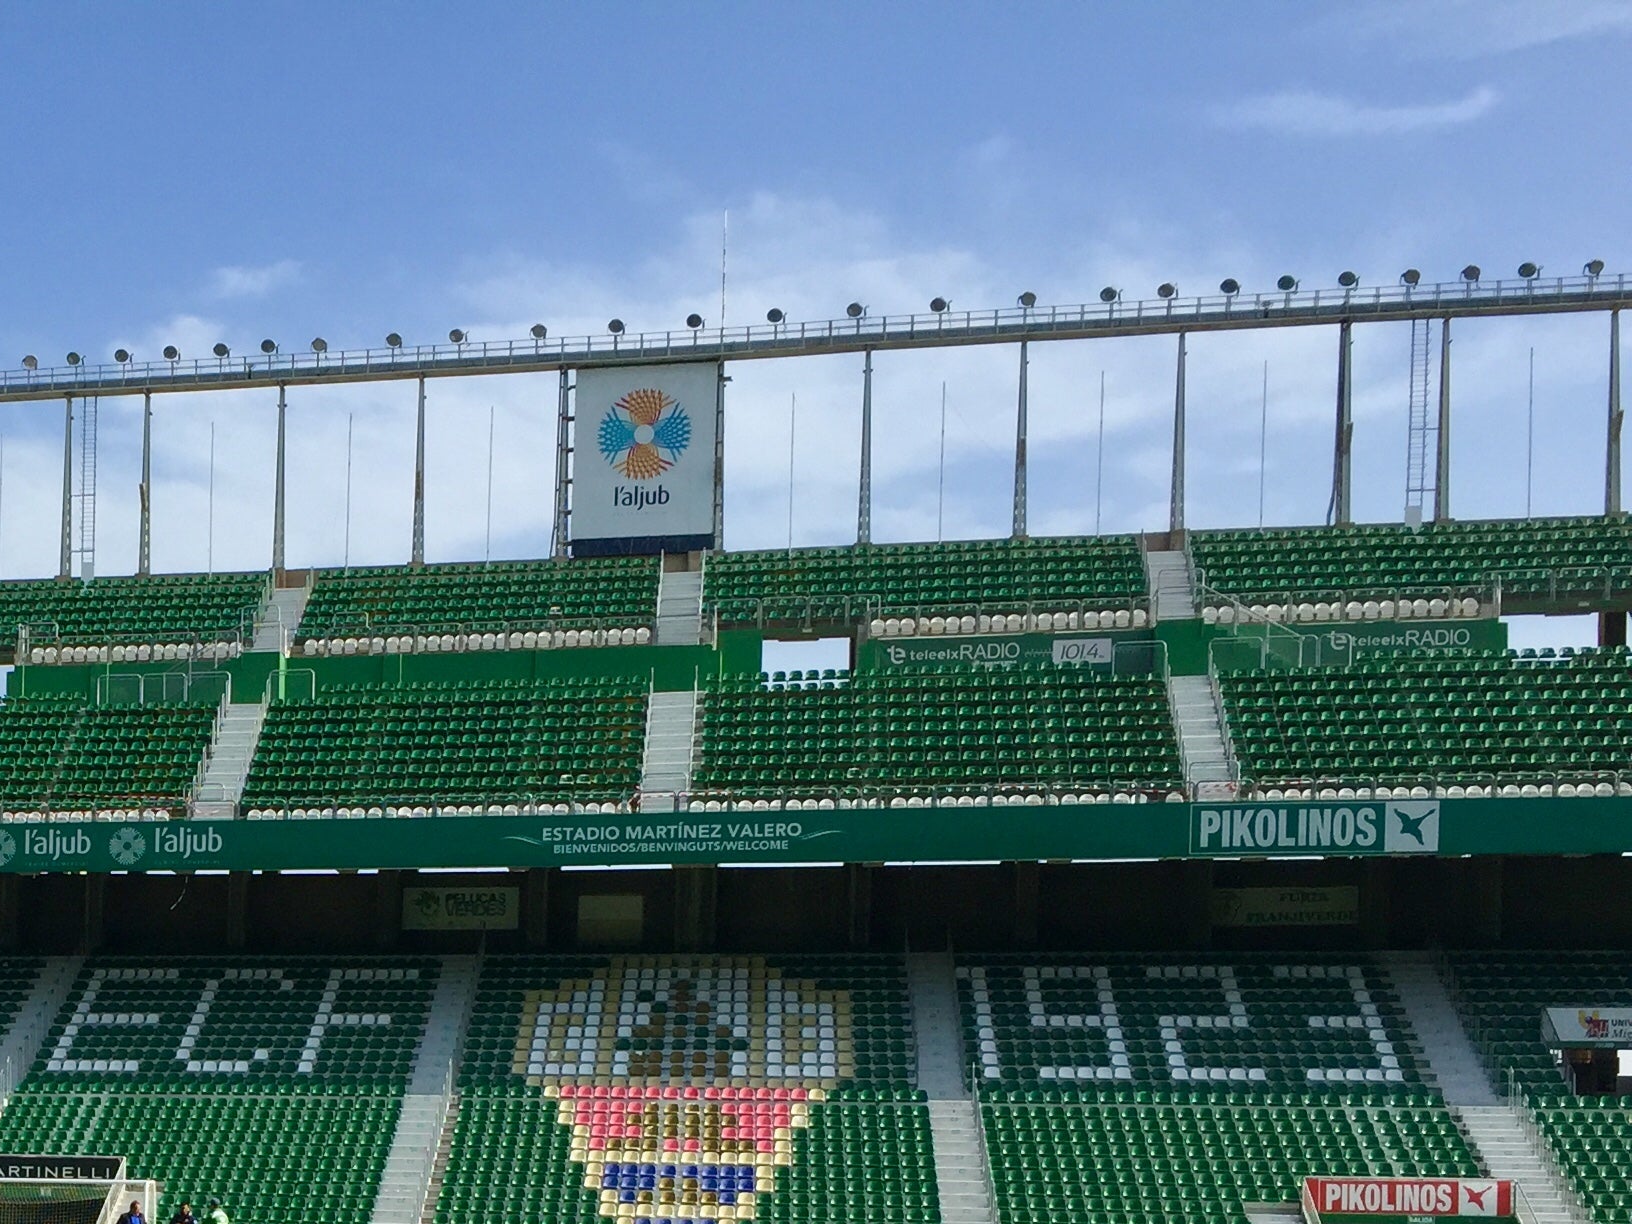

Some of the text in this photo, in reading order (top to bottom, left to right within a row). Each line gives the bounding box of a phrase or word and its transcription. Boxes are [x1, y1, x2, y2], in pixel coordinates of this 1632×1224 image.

[542, 822, 802, 841] ESTADIO MARTÍNEZ VALERO
[1200, 807, 1376, 847] PIKOLINOS
[554, 840, 789, 854] BIENVENIDOS/BENVINGUTS/WELCOME
[1325, 1183, 1452, 1212] PIKOLINOS
